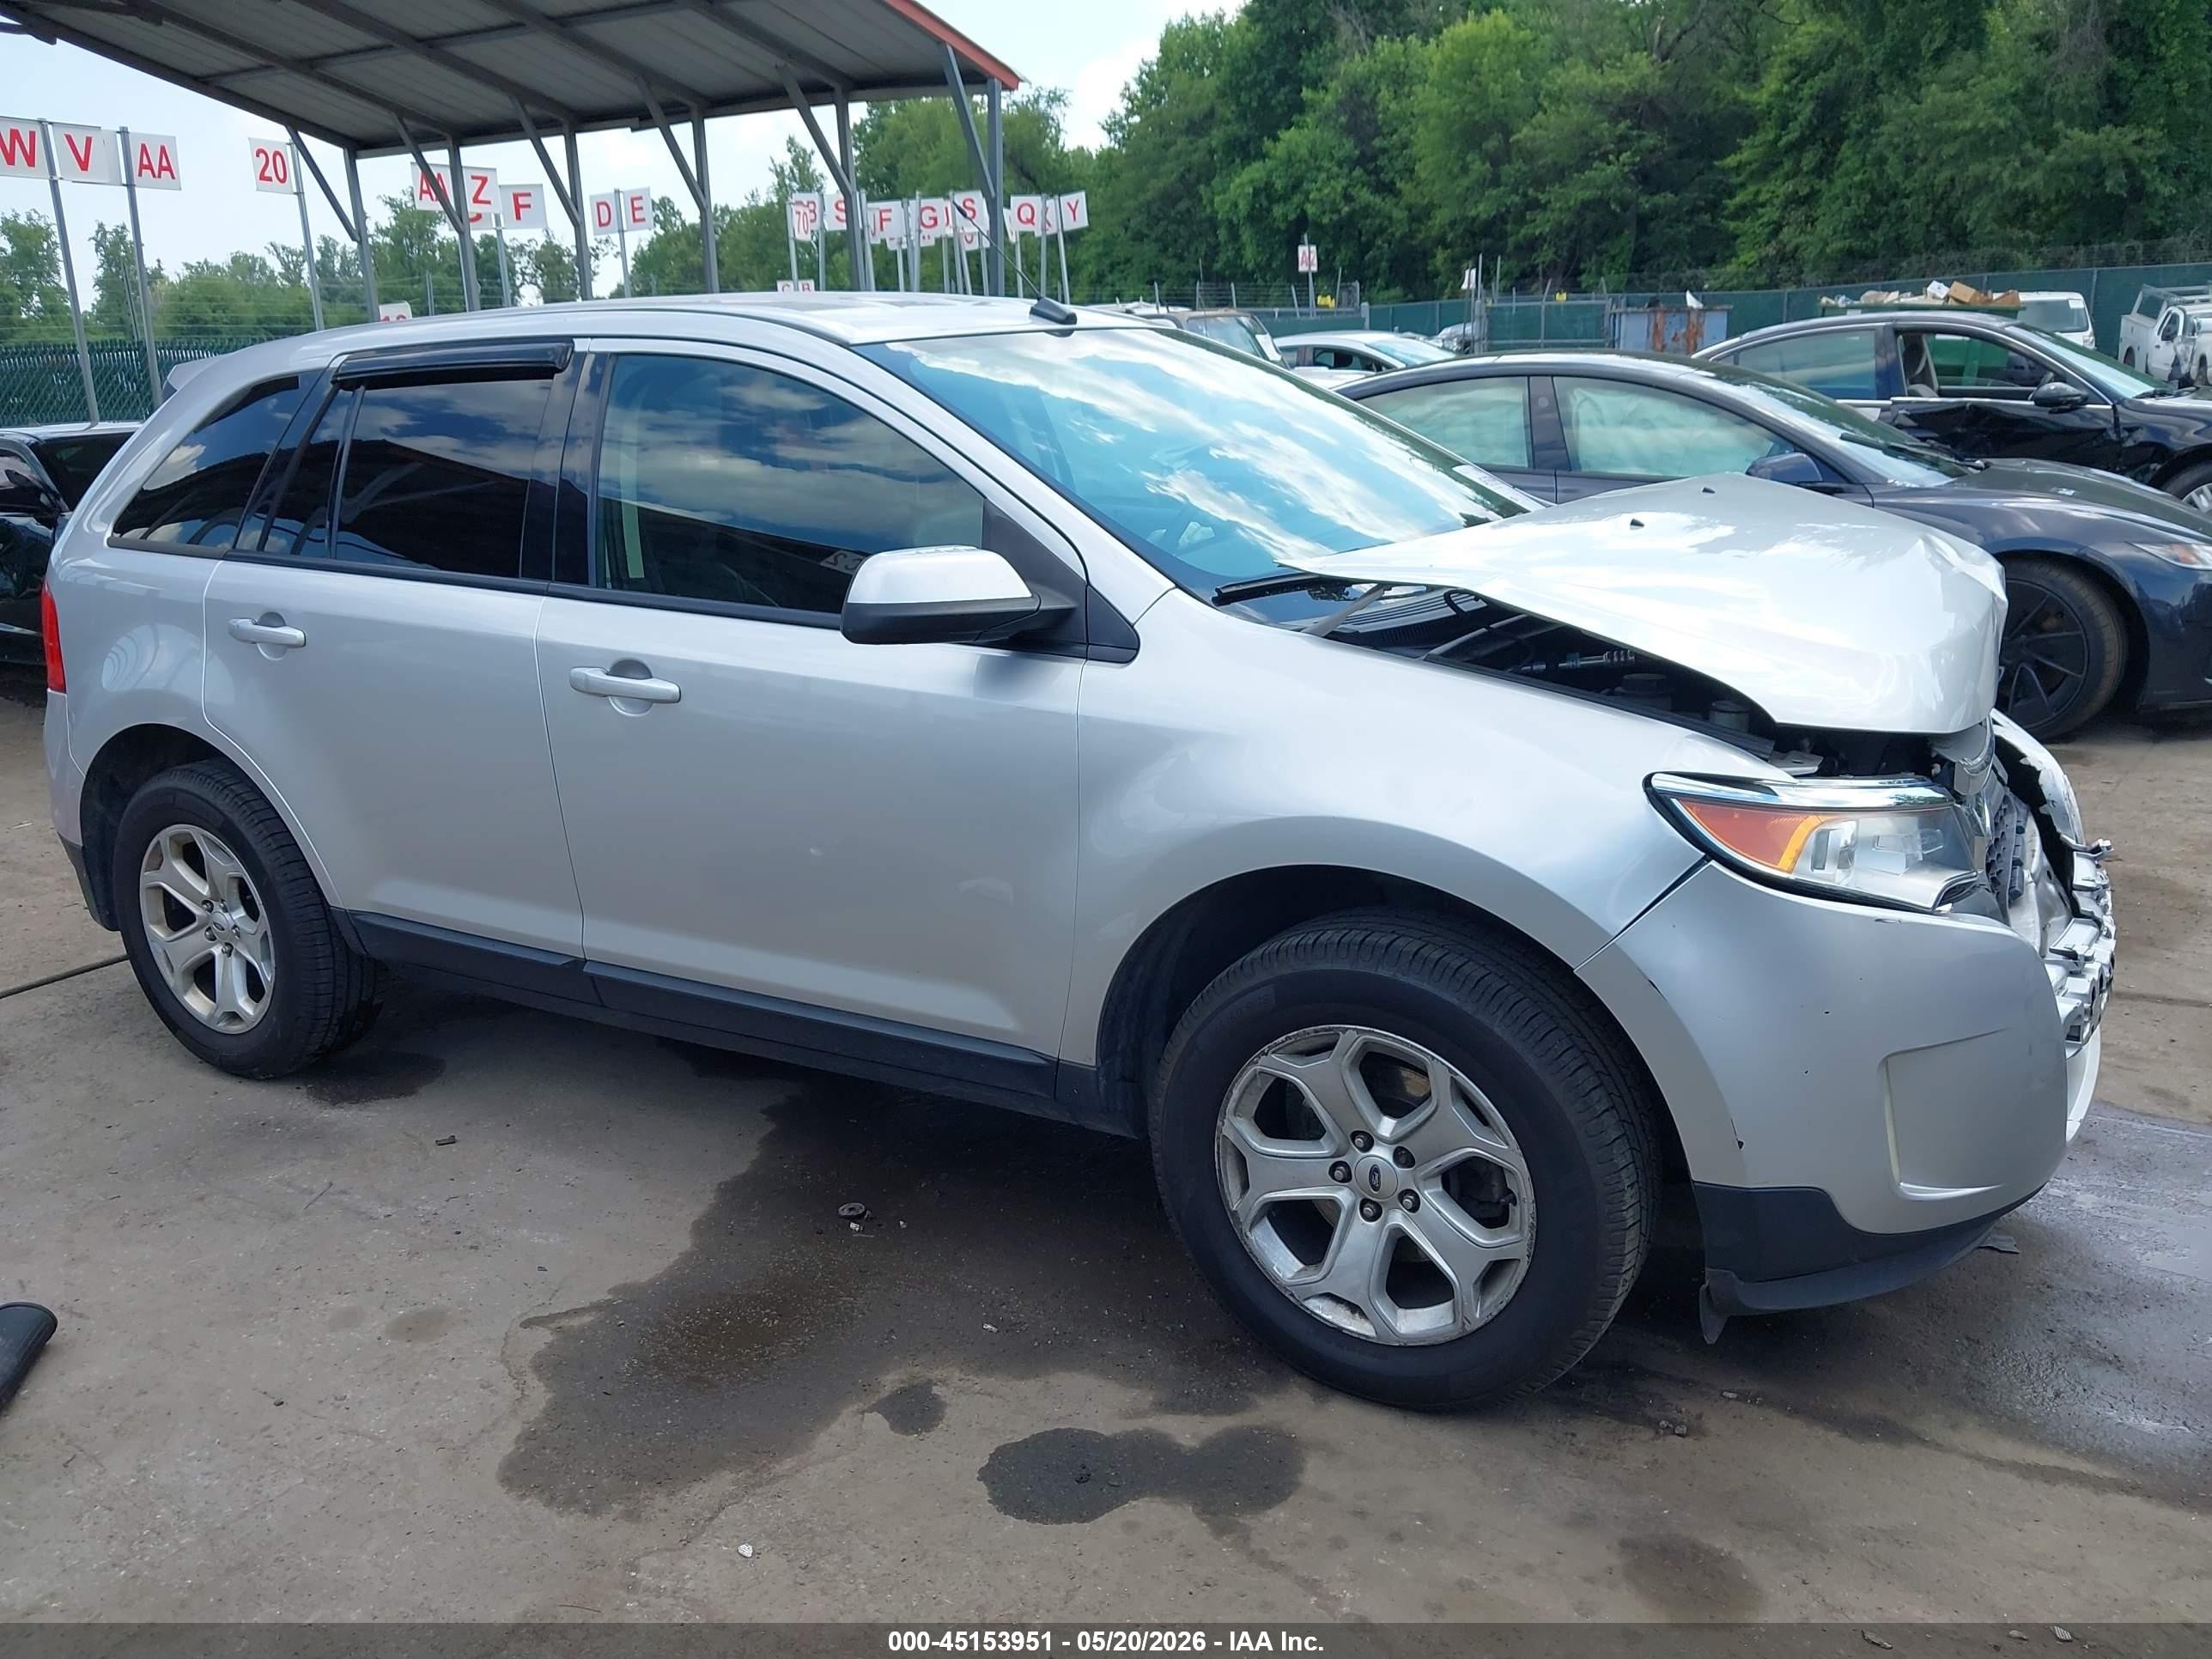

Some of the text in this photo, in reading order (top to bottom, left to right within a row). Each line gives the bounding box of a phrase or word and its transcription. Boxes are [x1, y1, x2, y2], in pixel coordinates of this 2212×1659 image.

[0, 128, 36, 167] W
[64, 133, 94, 172] V
[137, 143, 176, 180] AA
[255, 148, 288, 184] 20
[471, 174, 491, 205] Z
[512, 191, 532, 221] F
[596, 201, 611, 228] D
[630, 196, 647, 223] E
[921, 205, 939, 229] G
[962, 197, 976, 220] S
[1017, 202, 1036, 226] Q
[1066, 199, 1079, 222] Y
[795, 210, 809, 234] 70
[878, 208, 892, 232] F
